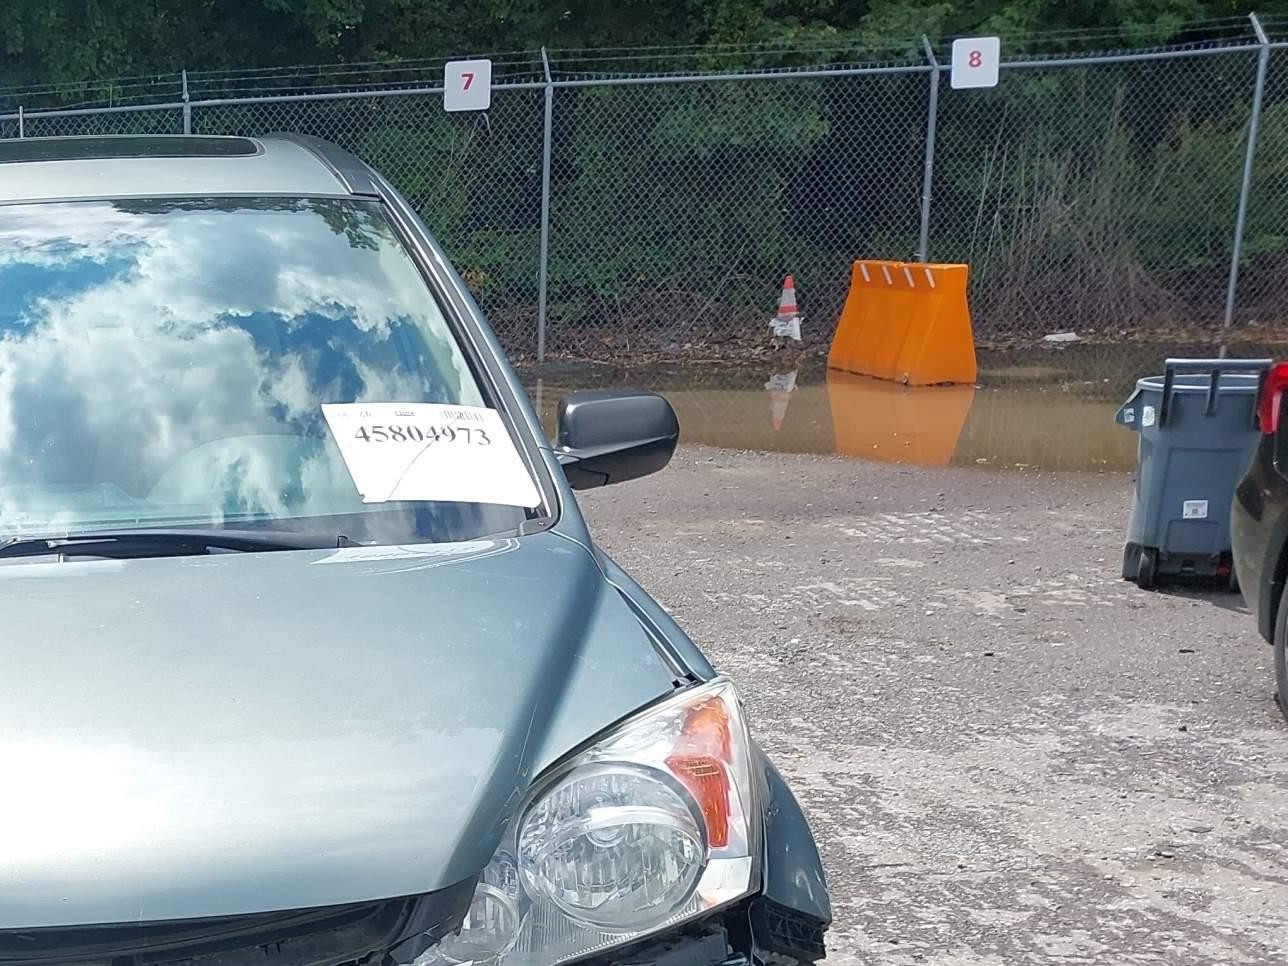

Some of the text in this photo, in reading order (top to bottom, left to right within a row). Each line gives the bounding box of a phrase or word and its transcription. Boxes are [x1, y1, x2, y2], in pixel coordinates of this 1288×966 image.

[968, 50, 982, 68] 8
[461, 73, 475, 90] 7
[354, 424, 492, 446] 45804973
